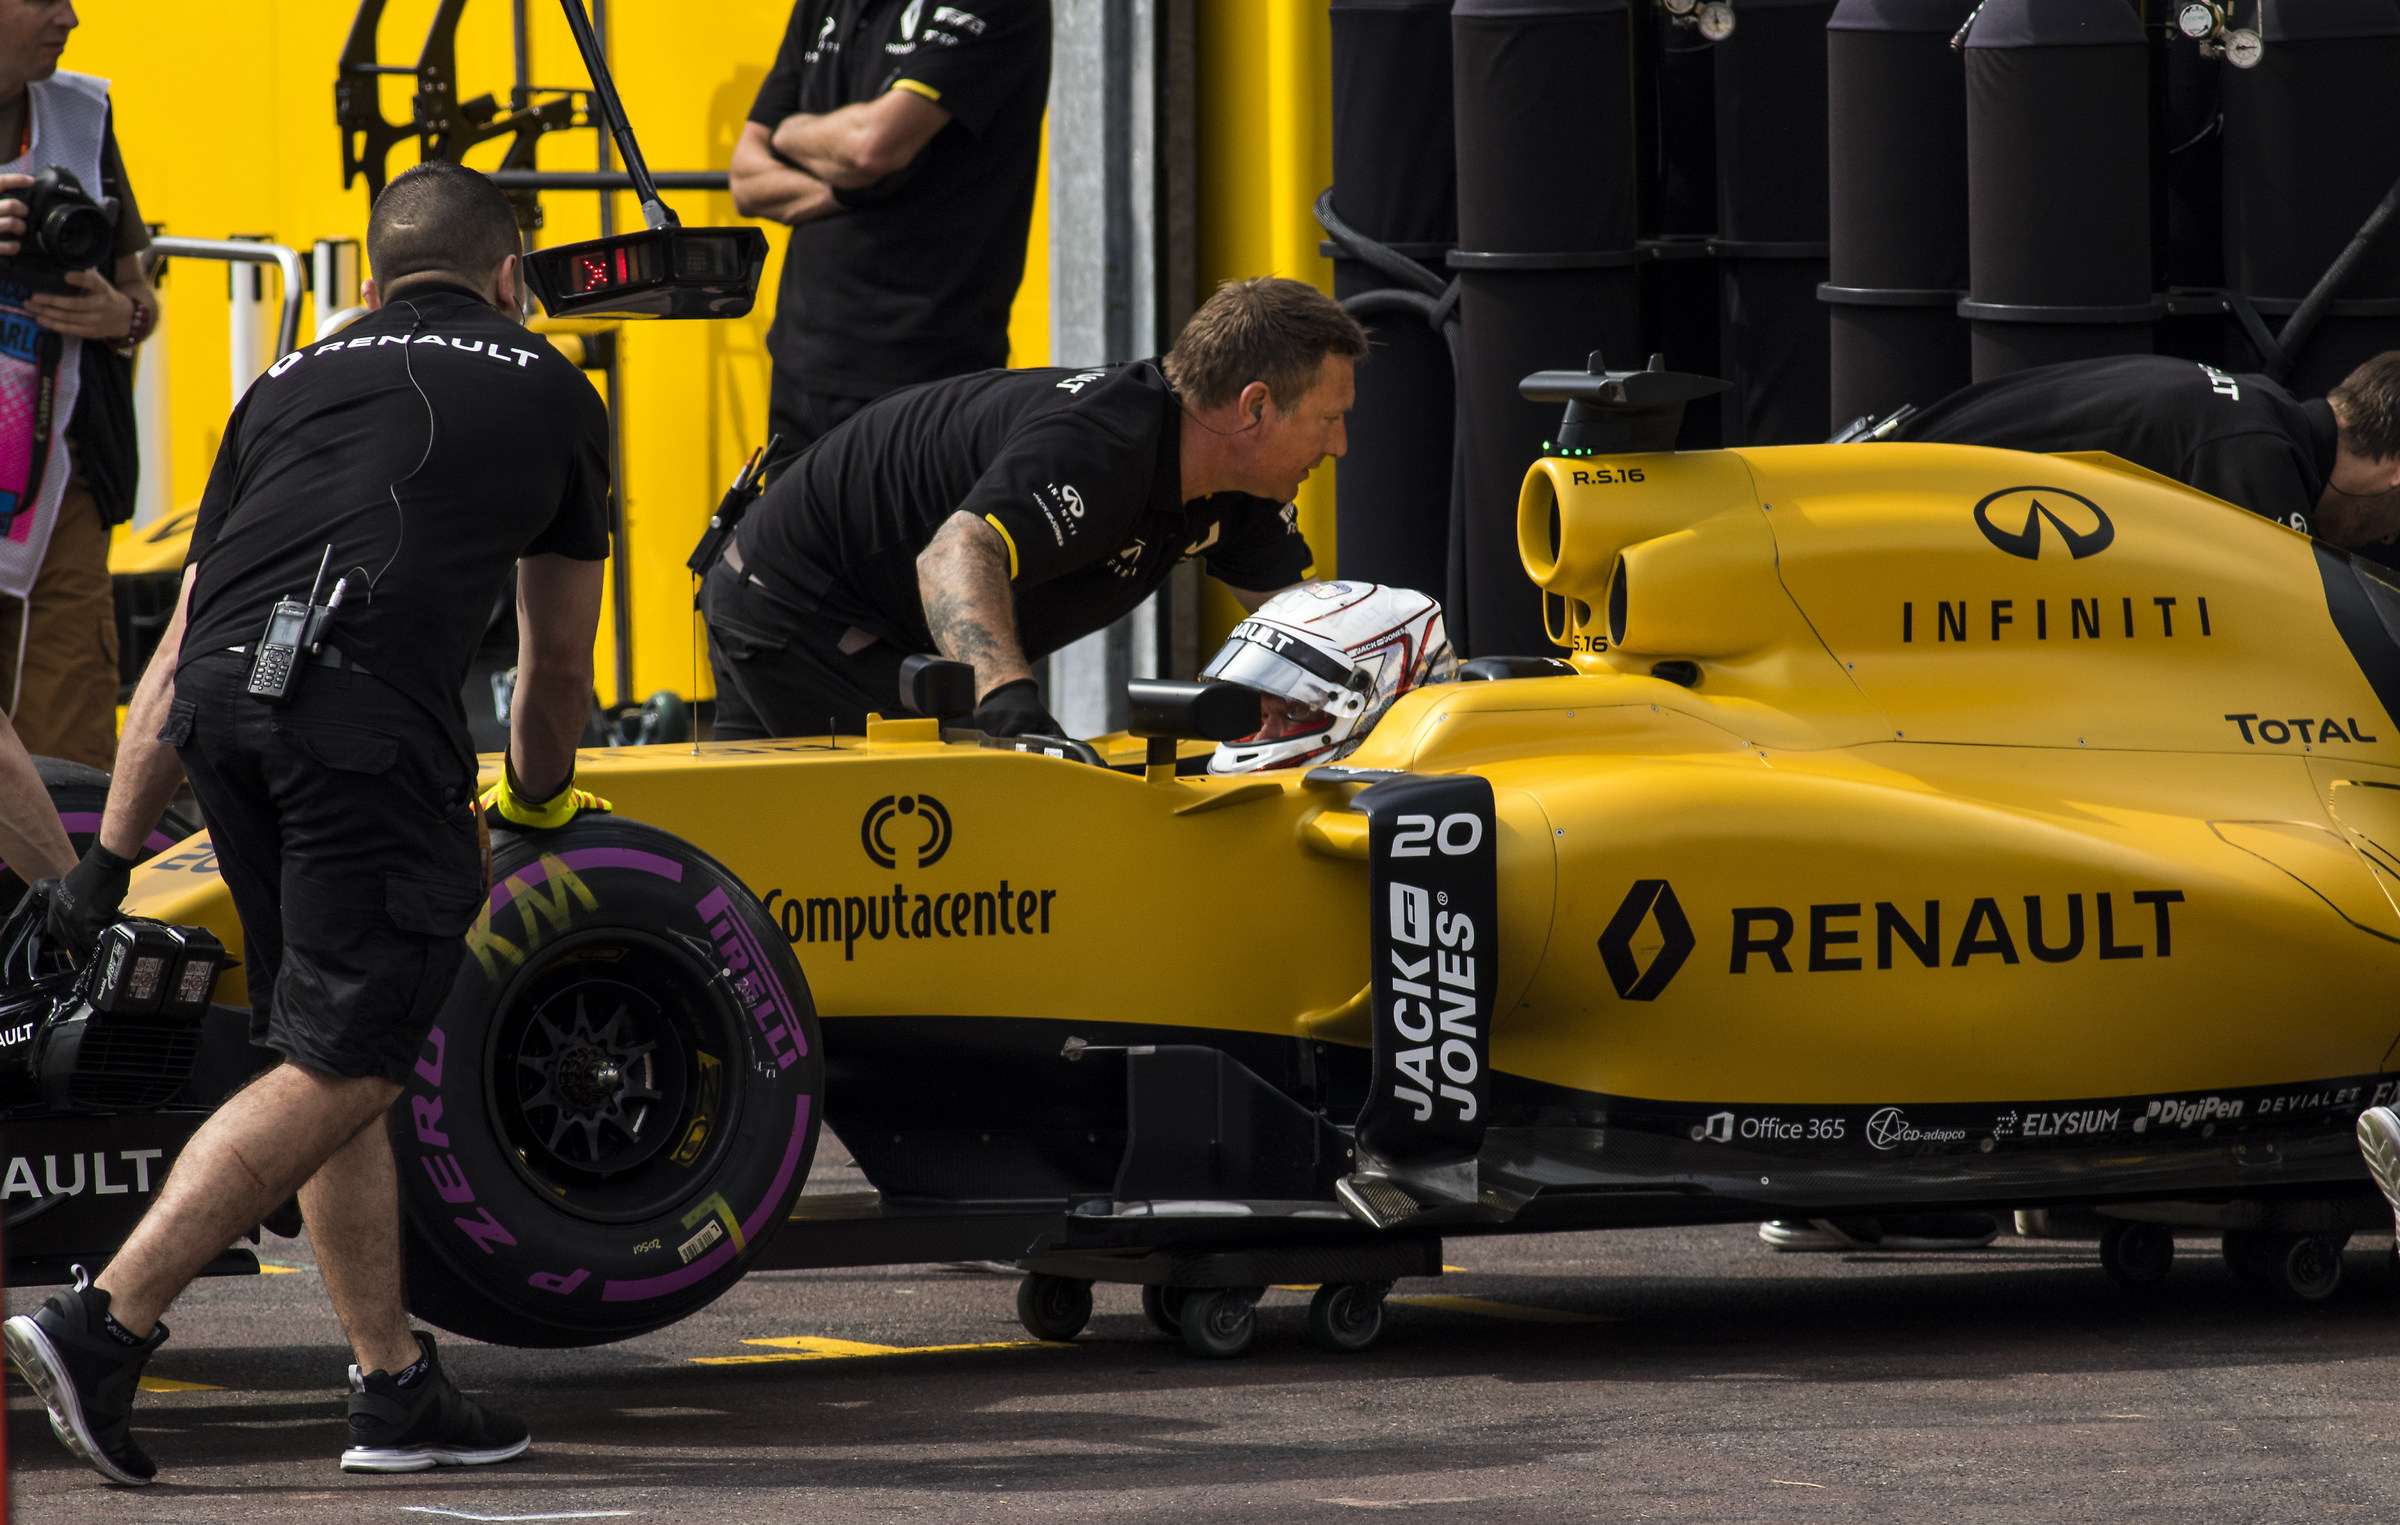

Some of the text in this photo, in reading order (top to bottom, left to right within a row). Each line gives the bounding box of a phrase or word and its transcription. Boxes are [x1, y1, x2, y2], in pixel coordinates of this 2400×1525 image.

[314, 334, 540, 367] RENAULT
[1572, 468, 1646, 486] R.S.16
[1047, 483, 1077, 536] INFINITI
[1903, 597, 2212, 643] INFINITI
[2224, 713, 2378, 745] TOTAL
[1391, 812, 1483, 858] 20
[1729, 889, 2186, 975] RENAULT
[695, 885, 809, 1070] PIRELLI
[1391, 948, 1434, 1122] JACK
[2258, 1086, 2361, 1114] DEVIALET
[1741, 1117, 1845, 1139] Office 365
[1902, 1128, 1966, 1143] CD-adapco
[2023, 1108, 2121, 1137] ELYSIUM
[0, 1148, 163, 1200] AULT
